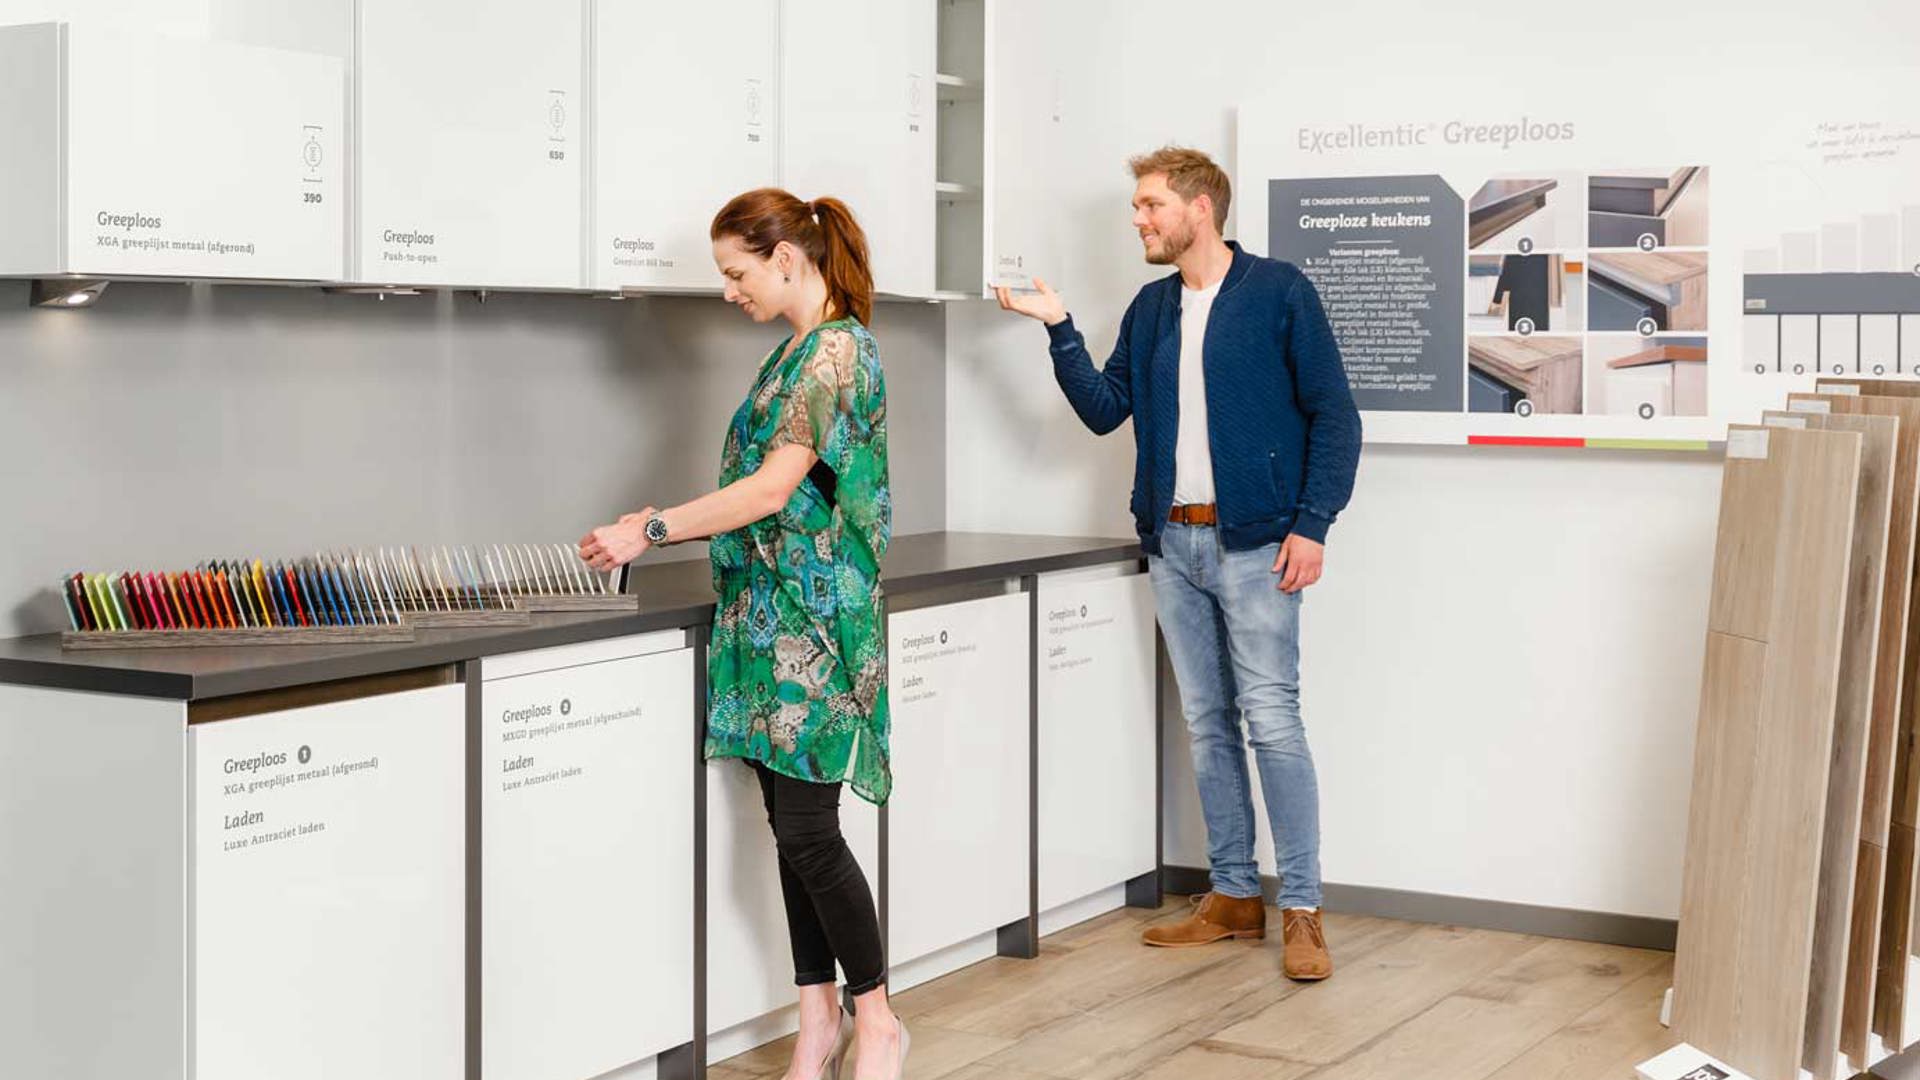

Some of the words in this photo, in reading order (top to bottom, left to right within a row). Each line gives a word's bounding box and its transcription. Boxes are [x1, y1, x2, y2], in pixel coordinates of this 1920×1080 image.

[1443, 117, 1575, 150] Greeploos
[303, 192, 322, 203] 390
[97, 211, 162, 231] Greeploos
[1299, 213, 1367, 232] Greeploze
[1371, 212, 1431, 227] keukens
[97, 236, 119, 247] XGA
[122, 238, 169, 250] greeplijst
[172, 240, 205, 250] metaal
[208, 241, 255, 256] (afgerond)
[383, 229, 434, 247] Greeploos
[613, 237, 655, 253] Greeploos
[503, 704, 552, 723] Greeploos
[529, 722, 565, 739] greeplijst
[224, 752, 287, 774] Greeploos
[503, 755, 534, 772] Laden
[561, 767, 582, 778] laden
[224, 783, 246, 795] XGA
[249, 773, 295, 793] greeplijst
[297, 766, 330, 781] metaal
[332, 757, 379, 777] (afgerond)
[224, 810, 264, 830] Laden
[223, 838, 248, 851] Luxe
[251, 825, 296, 845] Antraciet
[298, 822, 325, 836] laden
